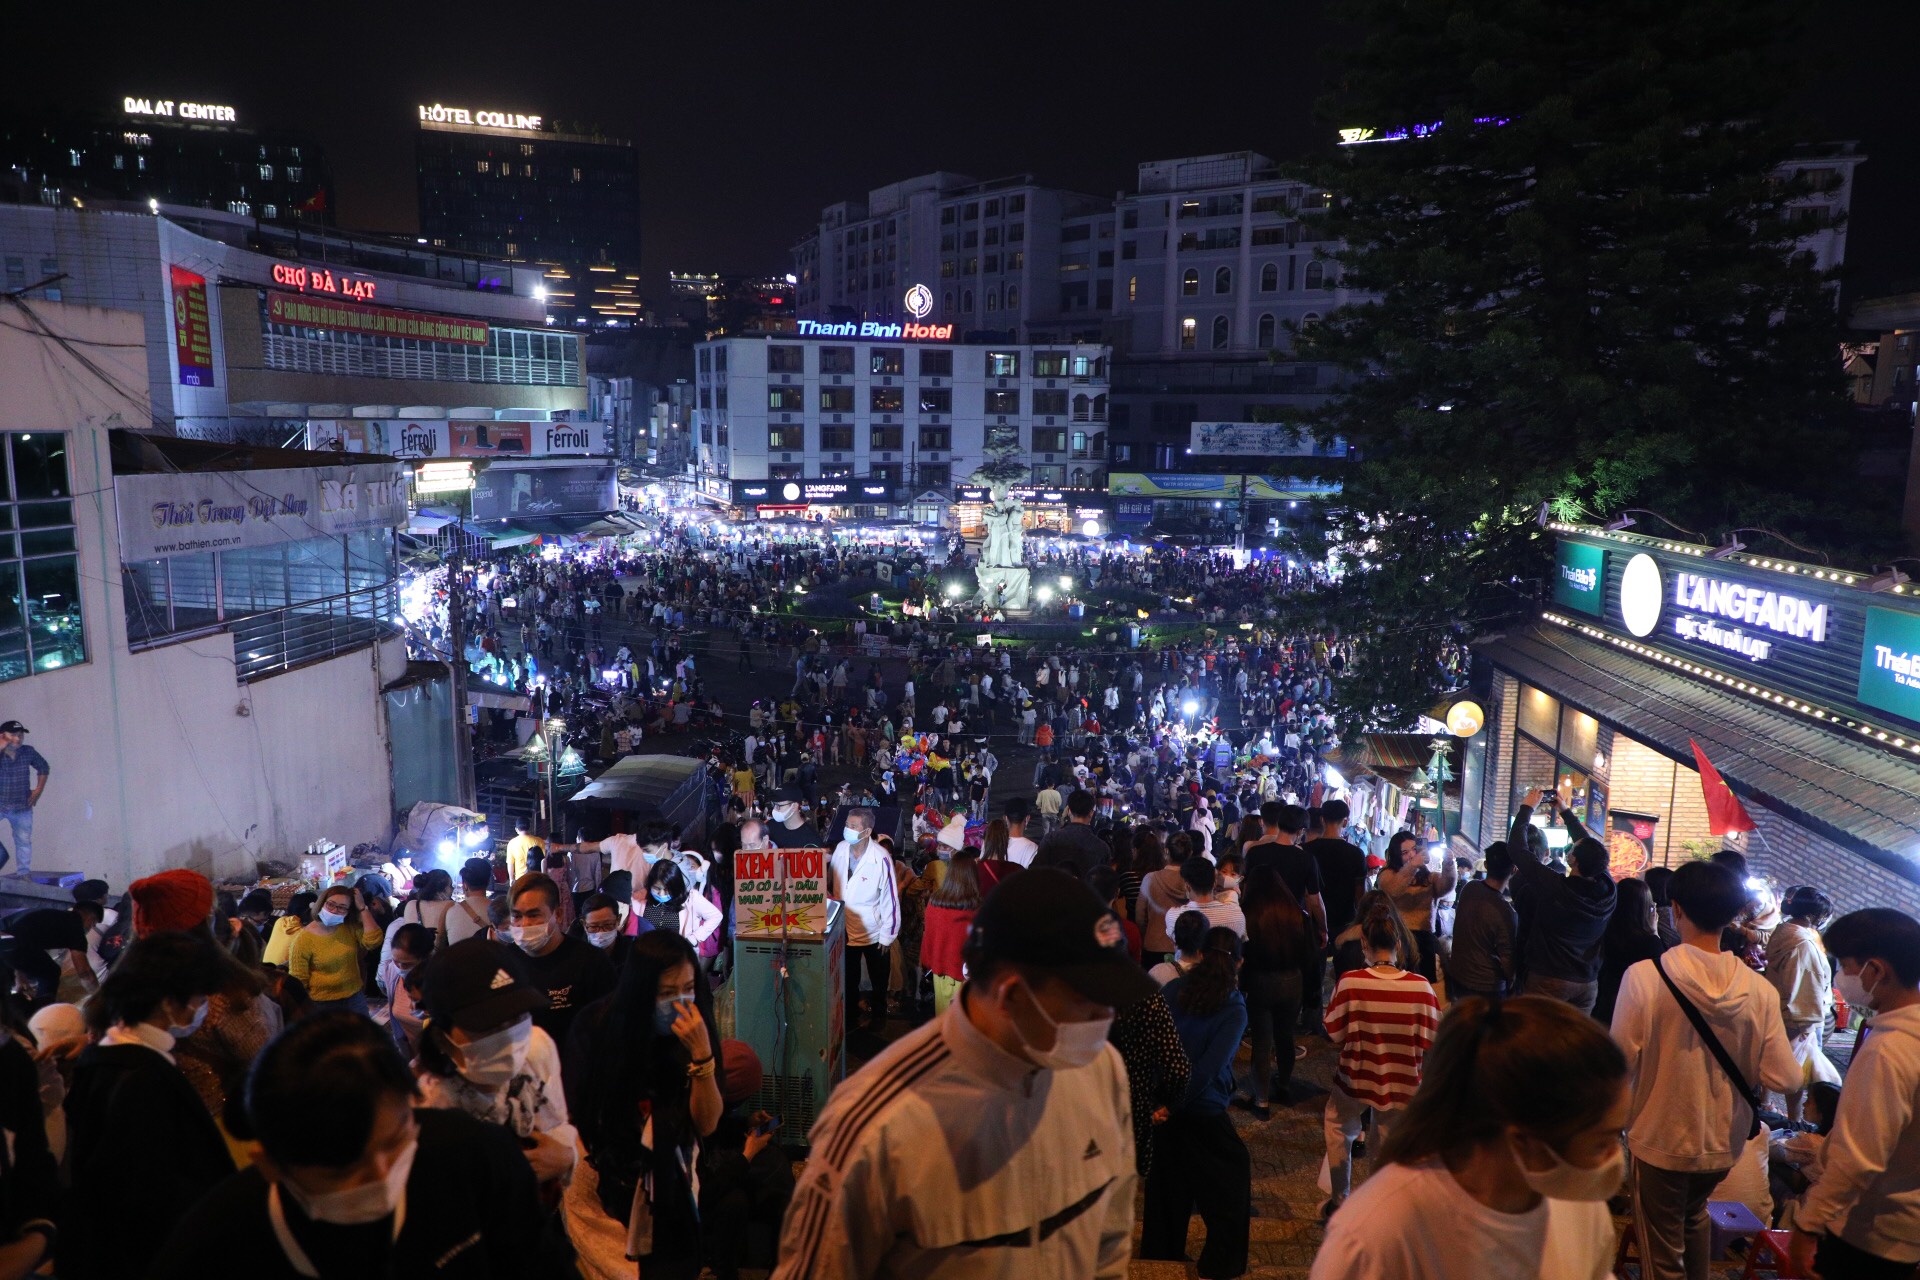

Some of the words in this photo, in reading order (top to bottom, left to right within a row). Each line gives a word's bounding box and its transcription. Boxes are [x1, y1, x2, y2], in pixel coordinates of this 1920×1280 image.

[179, 102, 236, 121] CENTER
[419, 103, 474, 125] HÔTEL
[476, 110, 542, 130] COLLINE
[273, 264, 306, 292] CHỢ
[311, 270, 336, 293] ĐÀ
[341, 278, 376, 301] LẠT
[797, 320, 857, 337] Thanh
[860, 321, 901, 338] Bình
[903, 323, 953, 339] Hotel
[401, 428, 437, 455] Ferroli
[546, 428, 589, 452] Ferroli
[474, 488, 493, 499] Legend
[805, 484, 847, 493] L'ANGFARM
[197, 498, 245, 526] Trang
[249, 494, 277, 523] Dệt
[1143, 505, 1151, 514] XE
[154, 535, 242, 553] www.bathien.com.vn
[1676, 572, 1828, 642] L'ANGFARM
[735, 852, 774, 879] KEM
[778, 850, 823, 879] TƯƠI
[794, 879, 818, 891] DÂU
[738, 894, 764, 905] VANI
[793, 893, 824, 904] XANH
